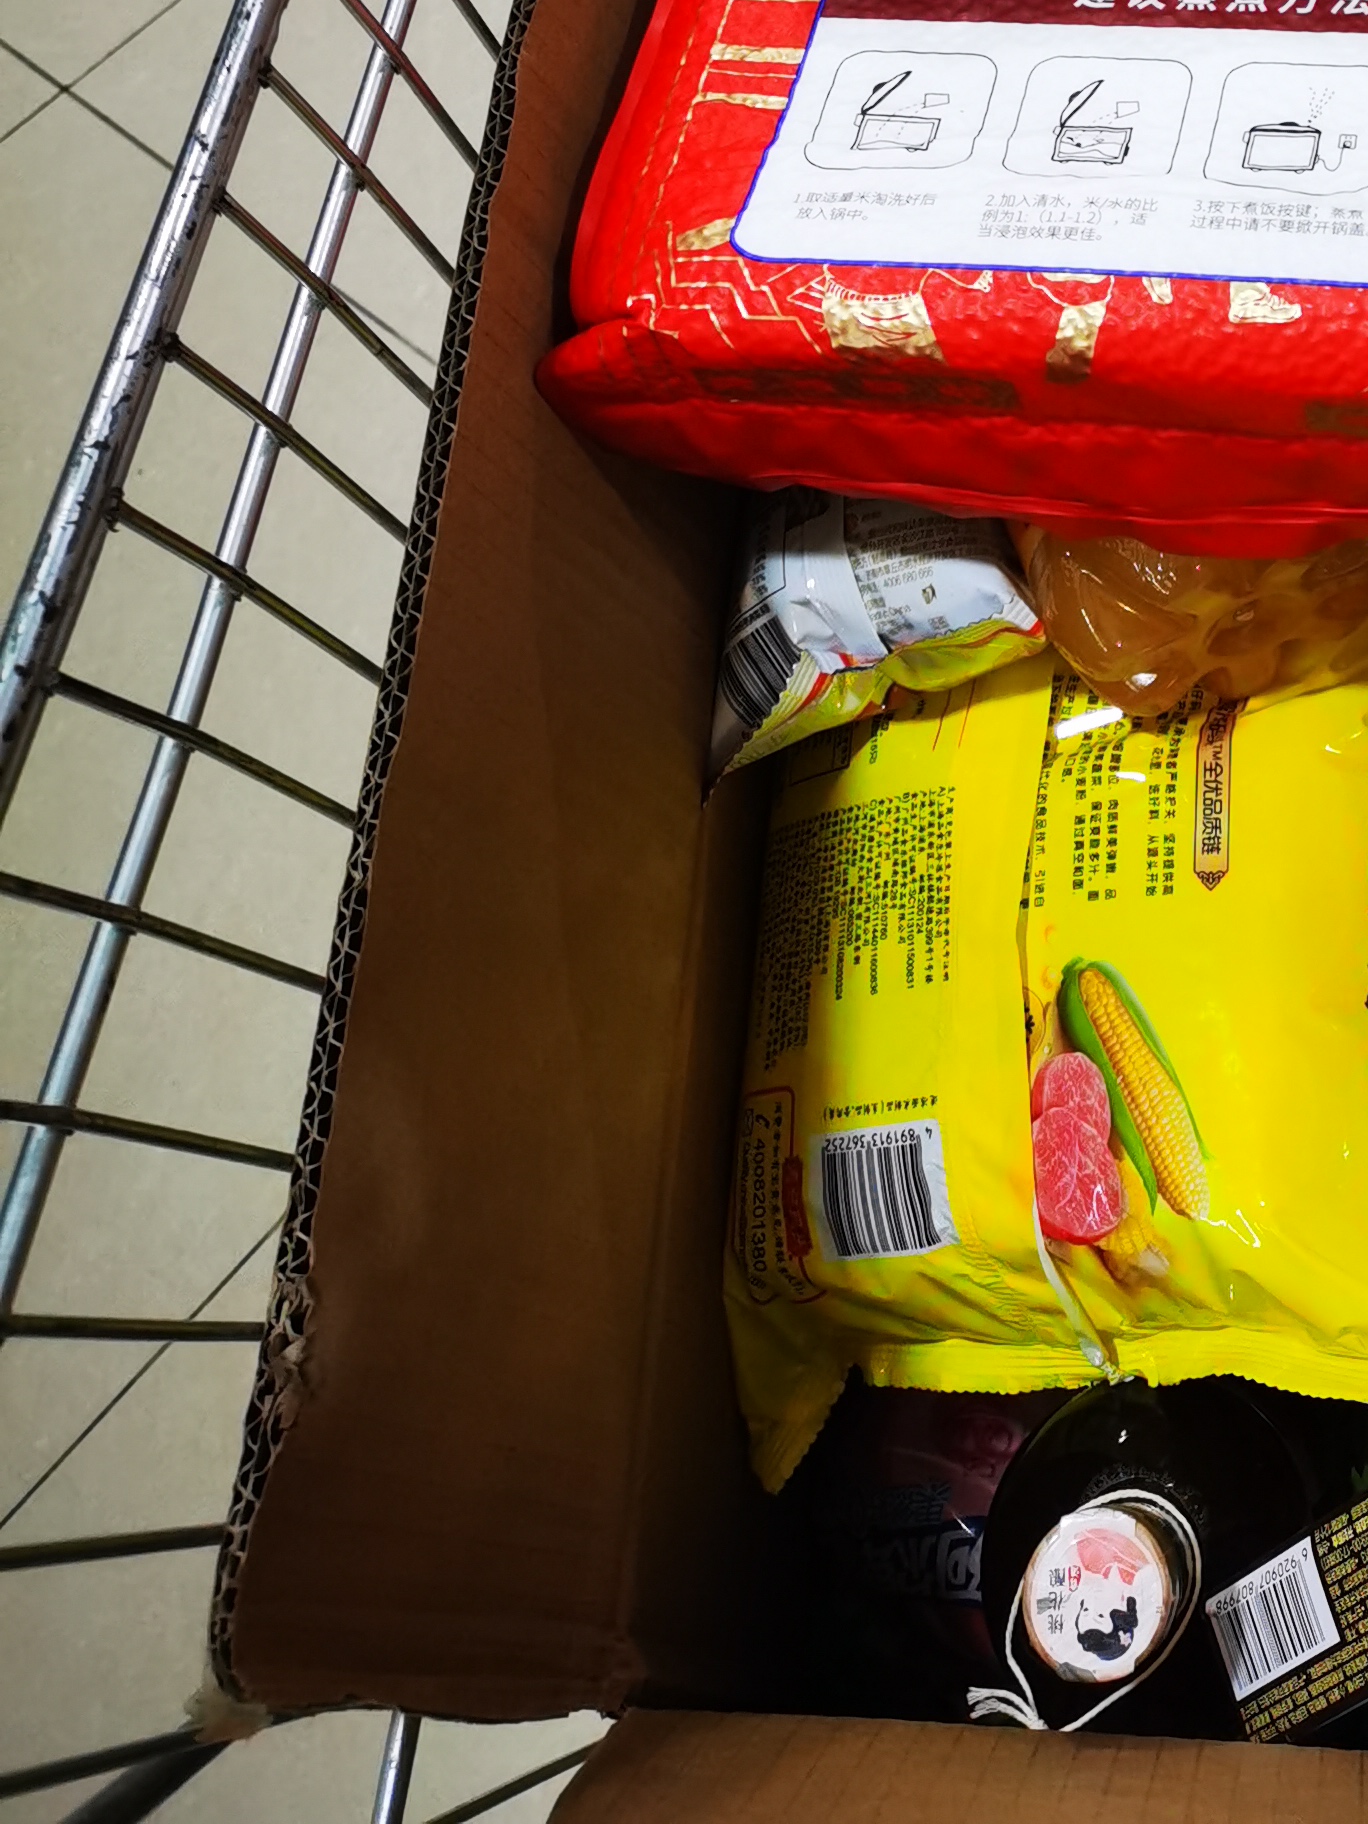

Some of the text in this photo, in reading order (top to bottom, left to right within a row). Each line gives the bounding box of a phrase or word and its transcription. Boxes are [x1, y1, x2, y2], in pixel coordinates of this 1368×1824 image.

[823, 1133, 868, 1154] 367252
[871, 1128, 915, 1148] 891913
[751, 1137, 768, 1273] 4008201380
[1255, 1554, 1300, 1590] 920907
[1213, 1579, 1257, 1615] 807998
